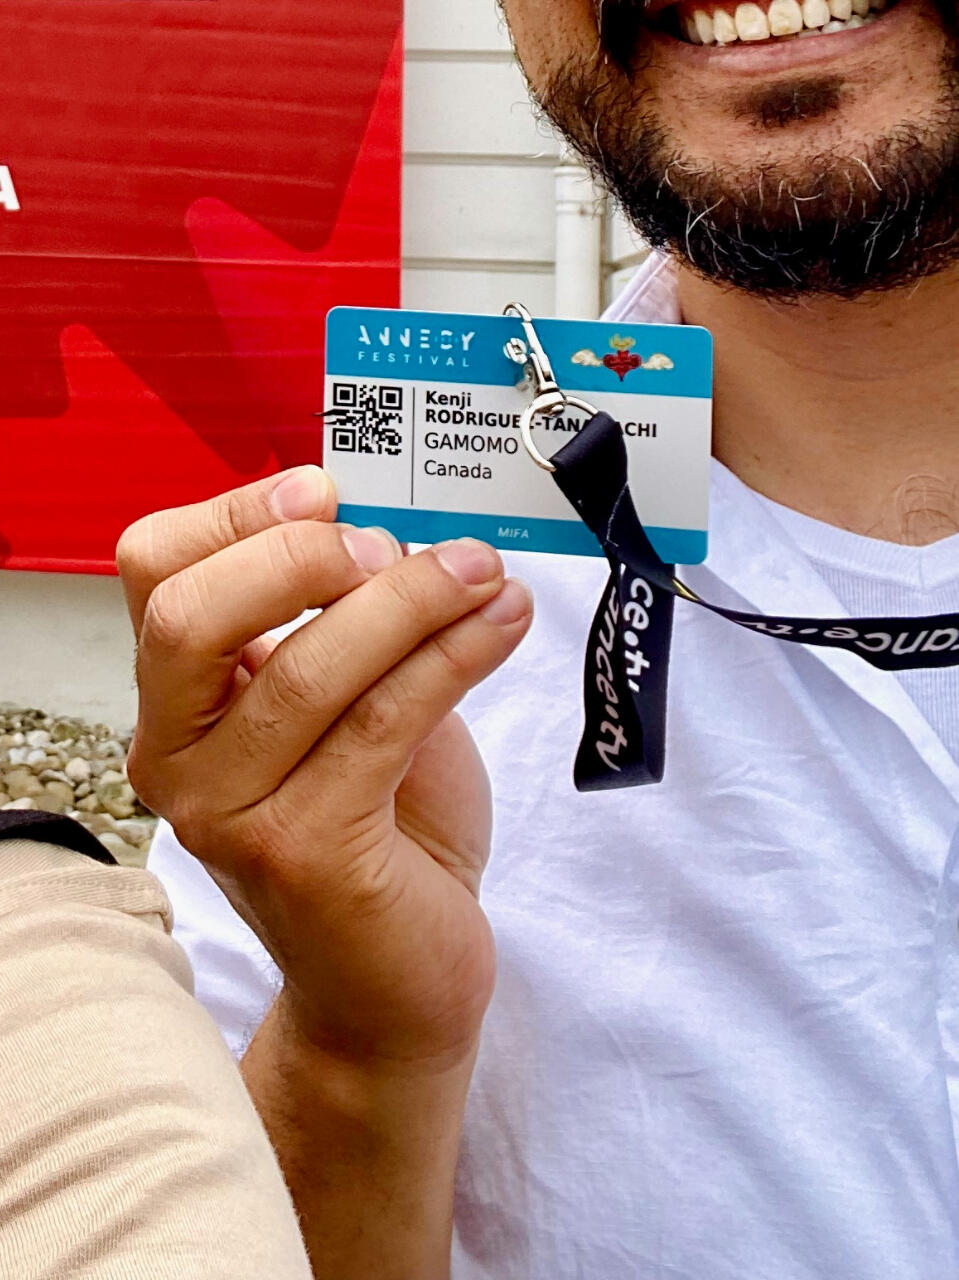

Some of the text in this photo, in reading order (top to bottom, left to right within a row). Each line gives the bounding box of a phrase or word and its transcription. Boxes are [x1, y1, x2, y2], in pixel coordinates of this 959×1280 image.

[358, 351, 469, 367] FESTIVAL
[425, 390, 472, 410] Kenji
[424, 432, 518, 455] GAMOMO
[424, 460, 492, 480] Canada
[497, 527, 529, 538] MIFA
